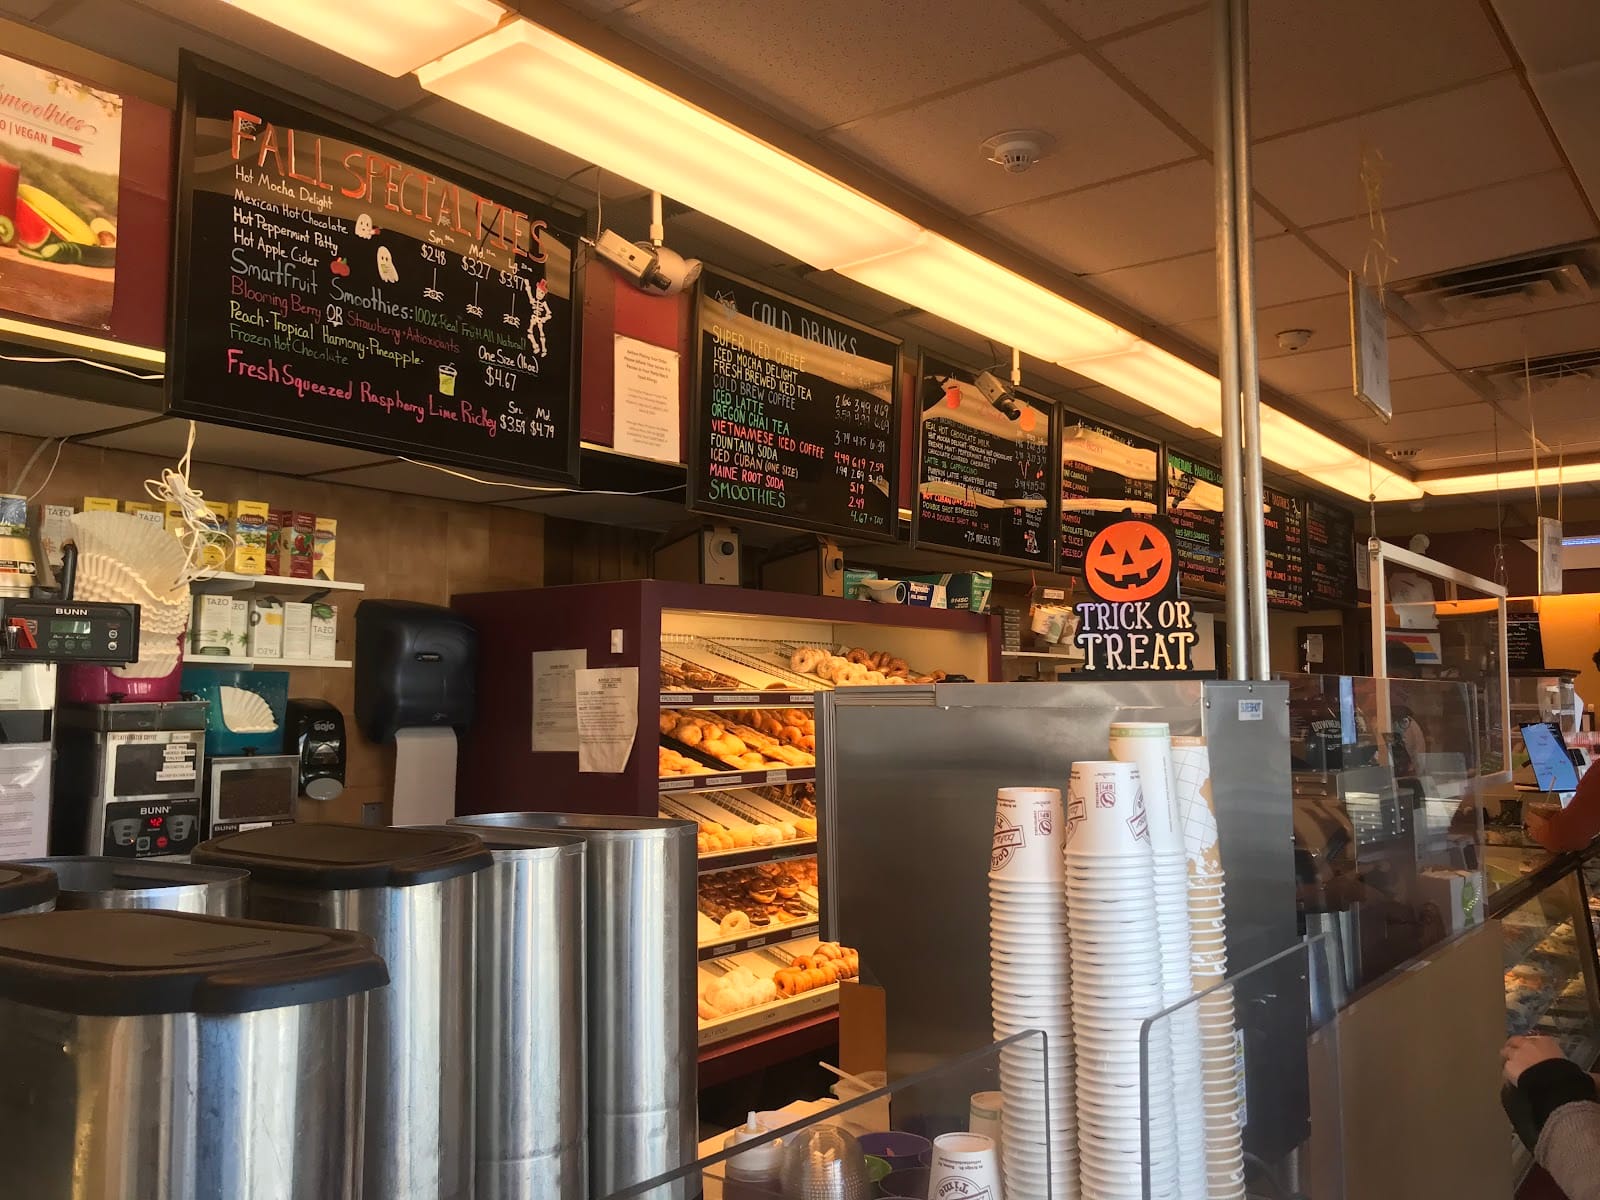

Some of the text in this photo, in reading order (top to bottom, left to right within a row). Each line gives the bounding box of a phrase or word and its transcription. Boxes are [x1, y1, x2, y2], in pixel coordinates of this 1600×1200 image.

[15, 124, 47, 144] VEGAN
[232, 110, 548, 263] FALL SPECIALTIES
[235, 165, 333, 212] Hot Mocha Delight
[234, 188, 349, 235] Mexican Hot Chocolate
[233, 206, 339, 257] Hot Peppermint Patty
[233, 227, 320, 267] Hot Apple Cider
[231, 275, 288, 317] Blooming
[291, 294, 322, 324] Berry
[326, 304, 343, 323] OR
[346, 310, 400, 344] Strawberry
[230, 300, 264, 327] Peach
[269, 310, 314, 340] Tropical
[322, 325, 365, 360] Harmony
[230, 322, 349, 365] Frozen Hot Chocolate
[751, 301, 857, 356] COLD DRINKS
[478, 345, 496, 362] One
[496, 348, 516, 366] Size
[712, 325, 806, 372] SUPER ICED COFFEE
[484, 365, 517, 392] $4.67
[712, 359, 812, 402] FRESH BREWED ICED TEA
[713, 346, 798, 384] ICED MOCHA DELIGHT
[227, 348, 280, 382] Fresh
[282, 364, 353, 398] Squeezed
[360, 381, 424, 423] Raspberry
[428, 394, 457, 421] Lime
[713, 374, 796, 412] COLD BREW COFFEE
[712, 388, 764, 416] ICED LATTE
[500, 414, 526, 435] $3.59
[711, 402, 790, 436] OREGON CHAI TEA
[710, 432, 778, 462] FOUNTAIN SODA
[711, 418, 825, 460] VIETNAMESE ICED COFFEE
[709, 462, 785, 492] MAINE ROOT SODA
[710, 448, 799, 480] ICED CUBAN (ONE SIZE)
[708, 478, 786, 509] SMOOTHIES
[47, 508, 71, 518] TAZO
[138, 512, 162, 523] TAZO
[55, 608, 88, 616] BUNN
[206, 598, 230, 606] TAZO
[1076, 600, 1192, 632] TRICK OR
[312, 625, 334, 634] TAZO
[256, 647, 278, 656] TAZO
[1077, 632, 1195, 671] TREAT
[140, 806, 170, 815] BUNN
[939, 1180, 970, 1197] Time
